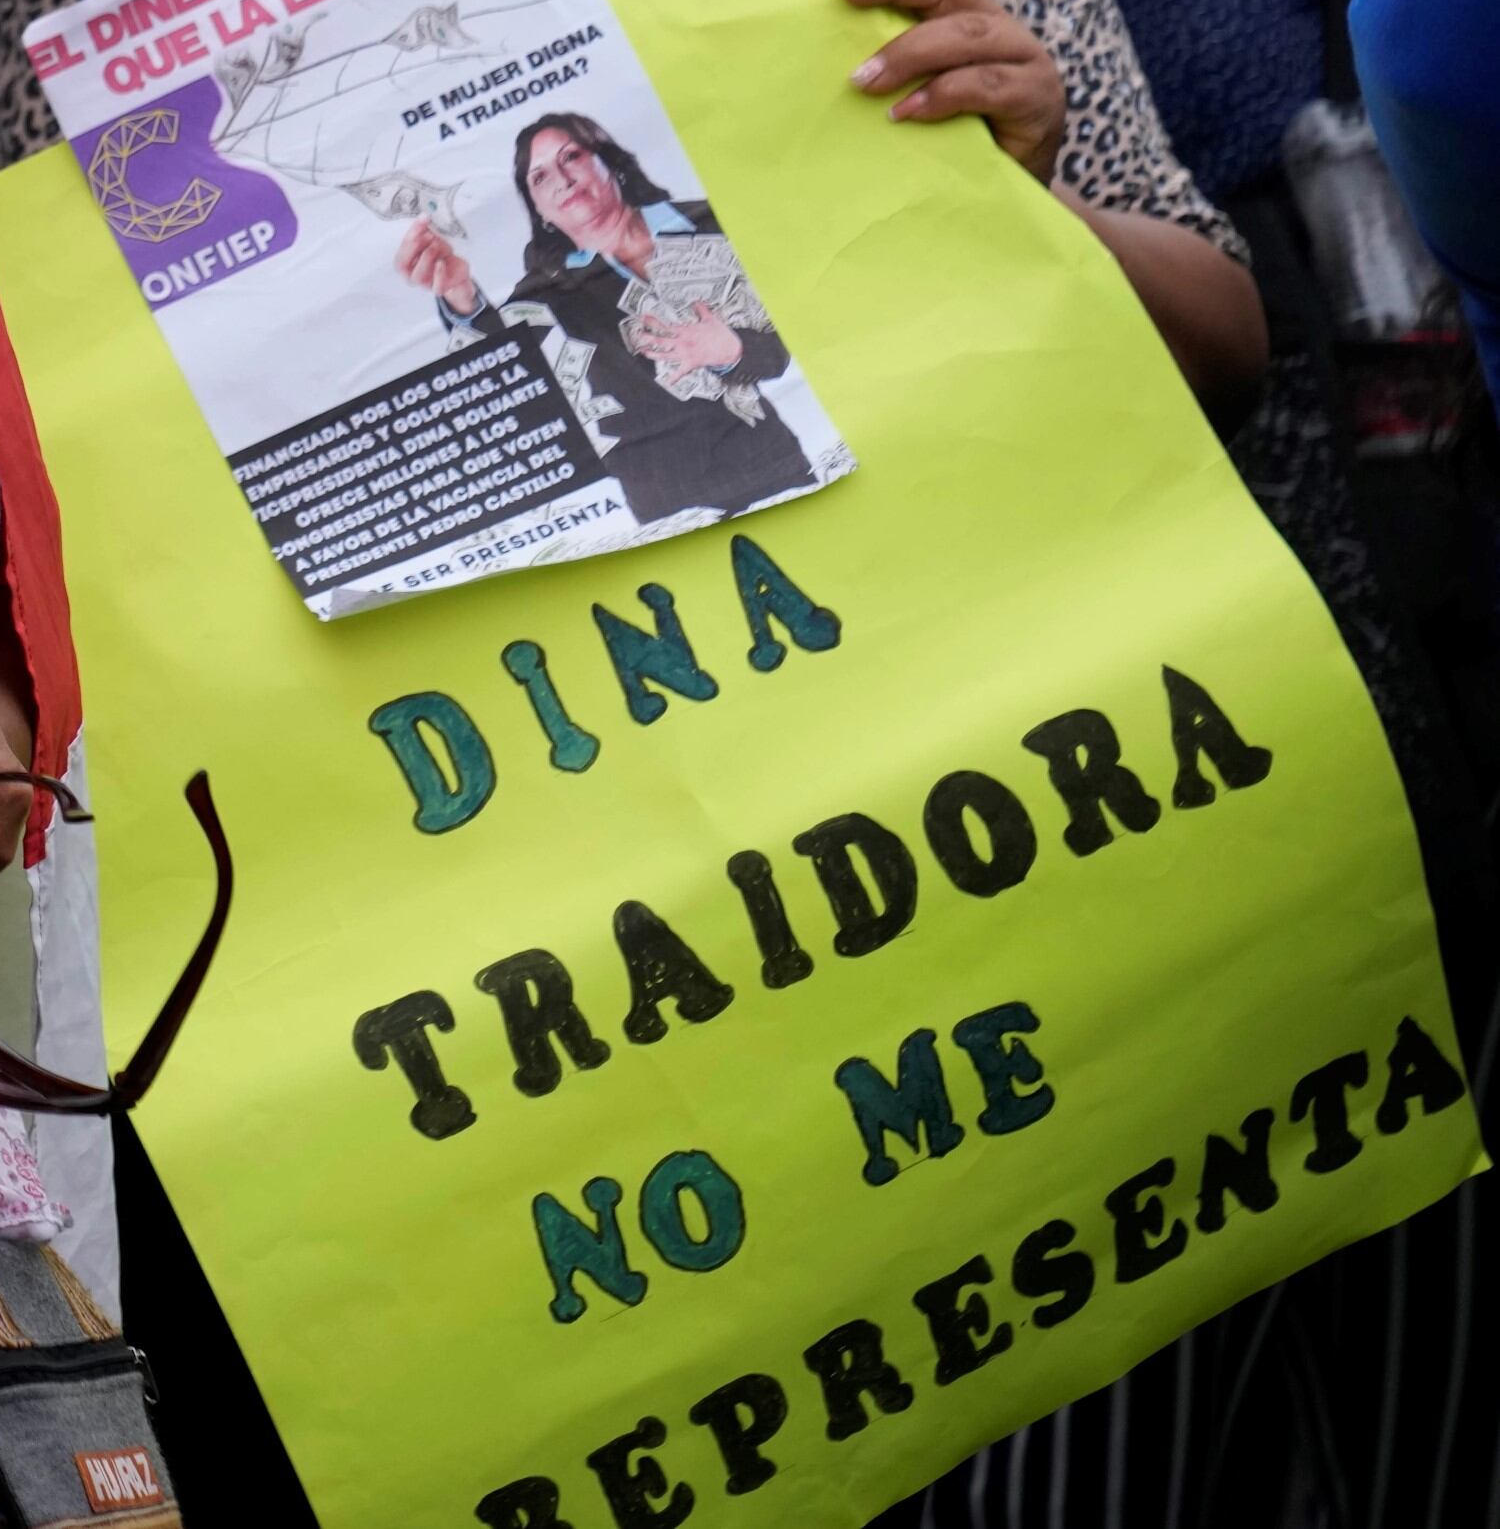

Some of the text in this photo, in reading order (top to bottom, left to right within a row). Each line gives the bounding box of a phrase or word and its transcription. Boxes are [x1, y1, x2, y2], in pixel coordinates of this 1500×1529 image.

[25, 33, 85, 81] EL
[102, 25, 213, 95] QUE
[402, 24, 603, 128] DE MUJER DIGNA
[439, 57, 589, 140] A TRAIDORA?
[141, 220, 275, 302] ONFIEP
[232, 341, 521, 484] FINANCIADA POR LOS GRANDES
[246, 363, 529, 503] EMPRESARIOS Y GOLPISTAS. LA
[402, 422, 453, 456] DINA
[452, 378, 549, 433] BOLUARTE
[408, 465, 463, 501] PARA
[462, 447, 504, 476] QUE
[502, 417, 568, 456] VOTEN
[295, 415, 520, 528] OFRECE MILLONES A LOS
[295, 443, 567, 573] A FAVOR DE LA VACANCIA DEL
[303, 462, 576, 586] PRESIDENTE PEDRO CASTILLO
[404, 564, 451, 590] SER
[460, 497, 622, 569] PRESIDENTA
[369, 534, 842, 835] DINA
[353, 664, 1272, 1140] TRAIDORA
[532, 1001, 1056, 1323] NO ME
